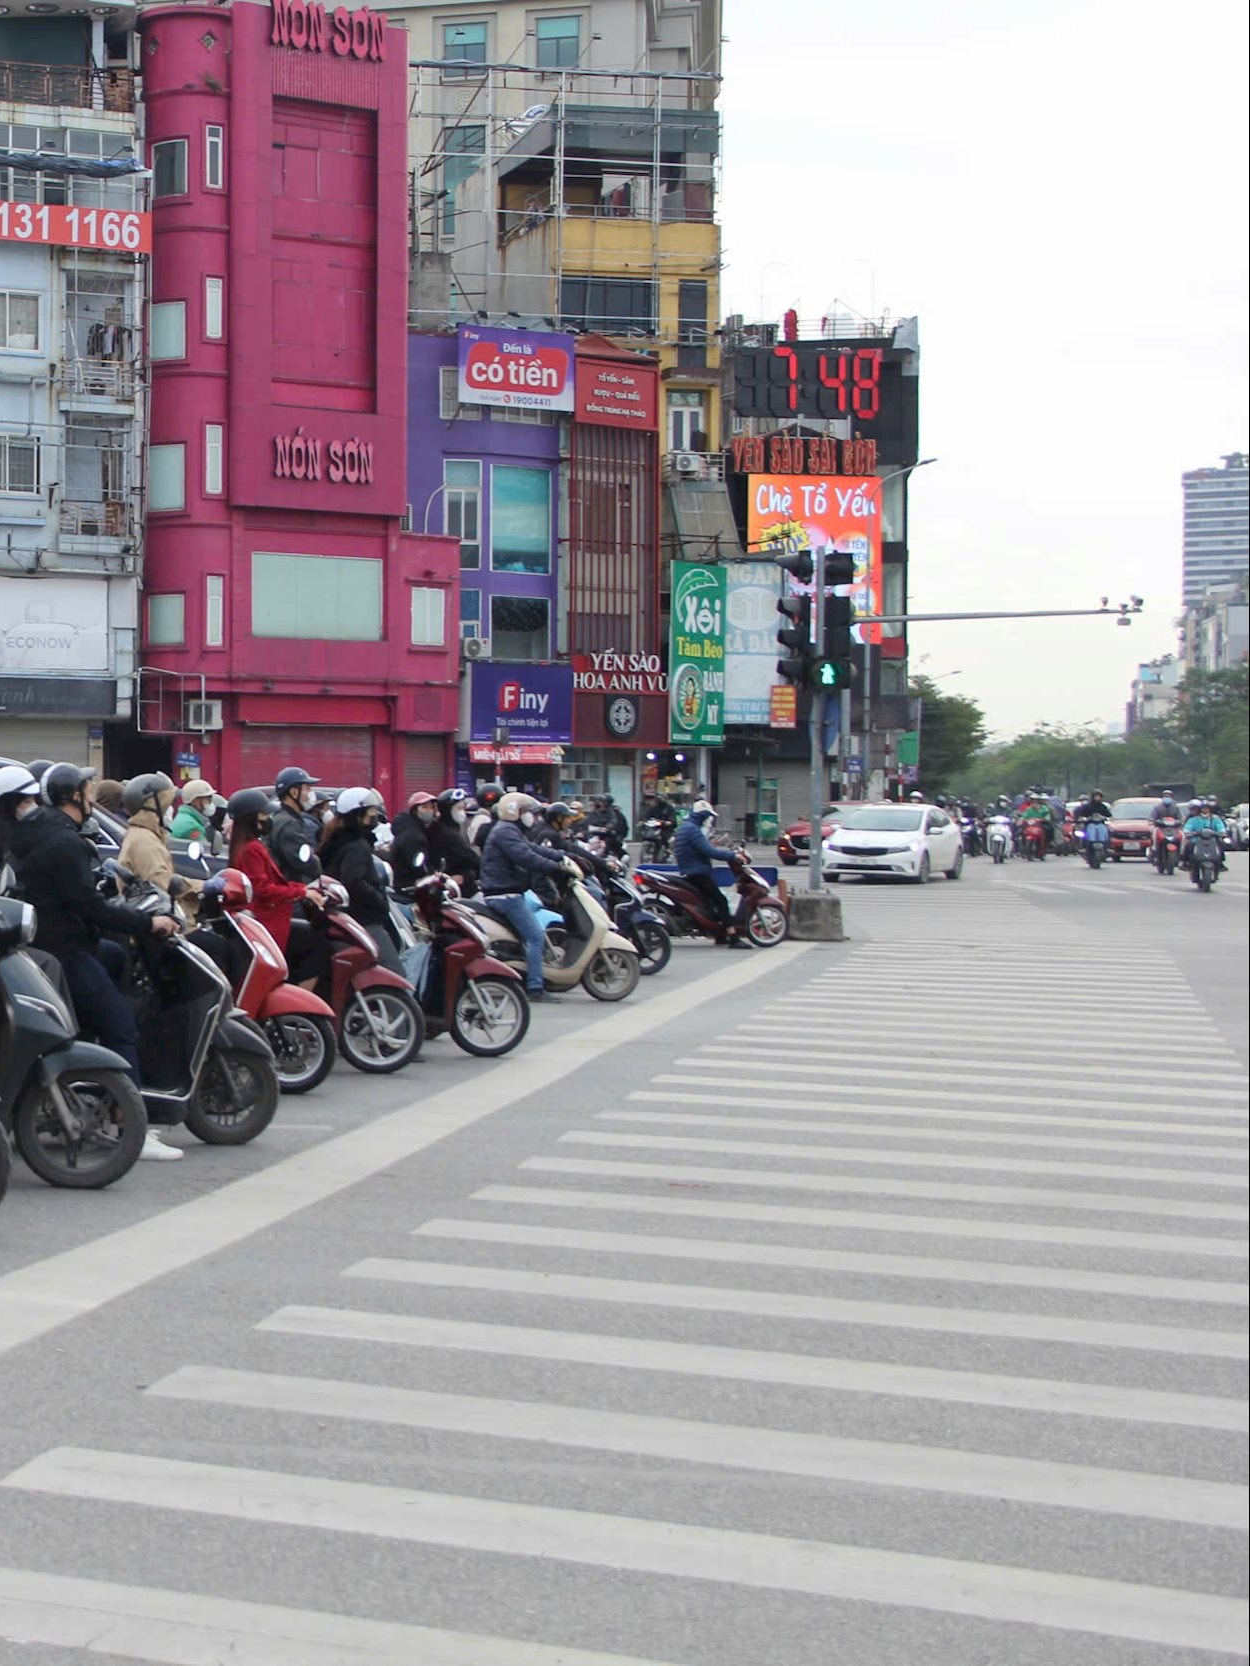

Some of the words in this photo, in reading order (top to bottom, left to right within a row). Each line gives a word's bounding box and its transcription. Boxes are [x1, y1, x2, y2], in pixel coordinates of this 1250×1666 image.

[333, 5, 387, 61] SƠN
[66, 208, 140, 248] 1166
[503, 343, 522, 354] Đến
[523, 343, 532, 355] là
[472, 356, 504, 383] có
[508, 359, 558, 388] tiền
[275, 426, 322, 480] NÓN
[329, 437, 373, 484] SƠN
[756, 484, 793, 516] Chè
[800, 482, 827, 517] Tổ
[835, 482, 876, 517] Yến
[684, 596, 721, 636] Xôi
[6, 636, 72, 649] ECONOW
[591, 648, 624, 672] YẾN
[629, 650, 660, 673] SÀO
[573, 672, 606, 690] HOA
[610, 674, 643, 692] ANH
[647, 673, 669, 692] VŨ
[504, 686, 549, 713] Finy
